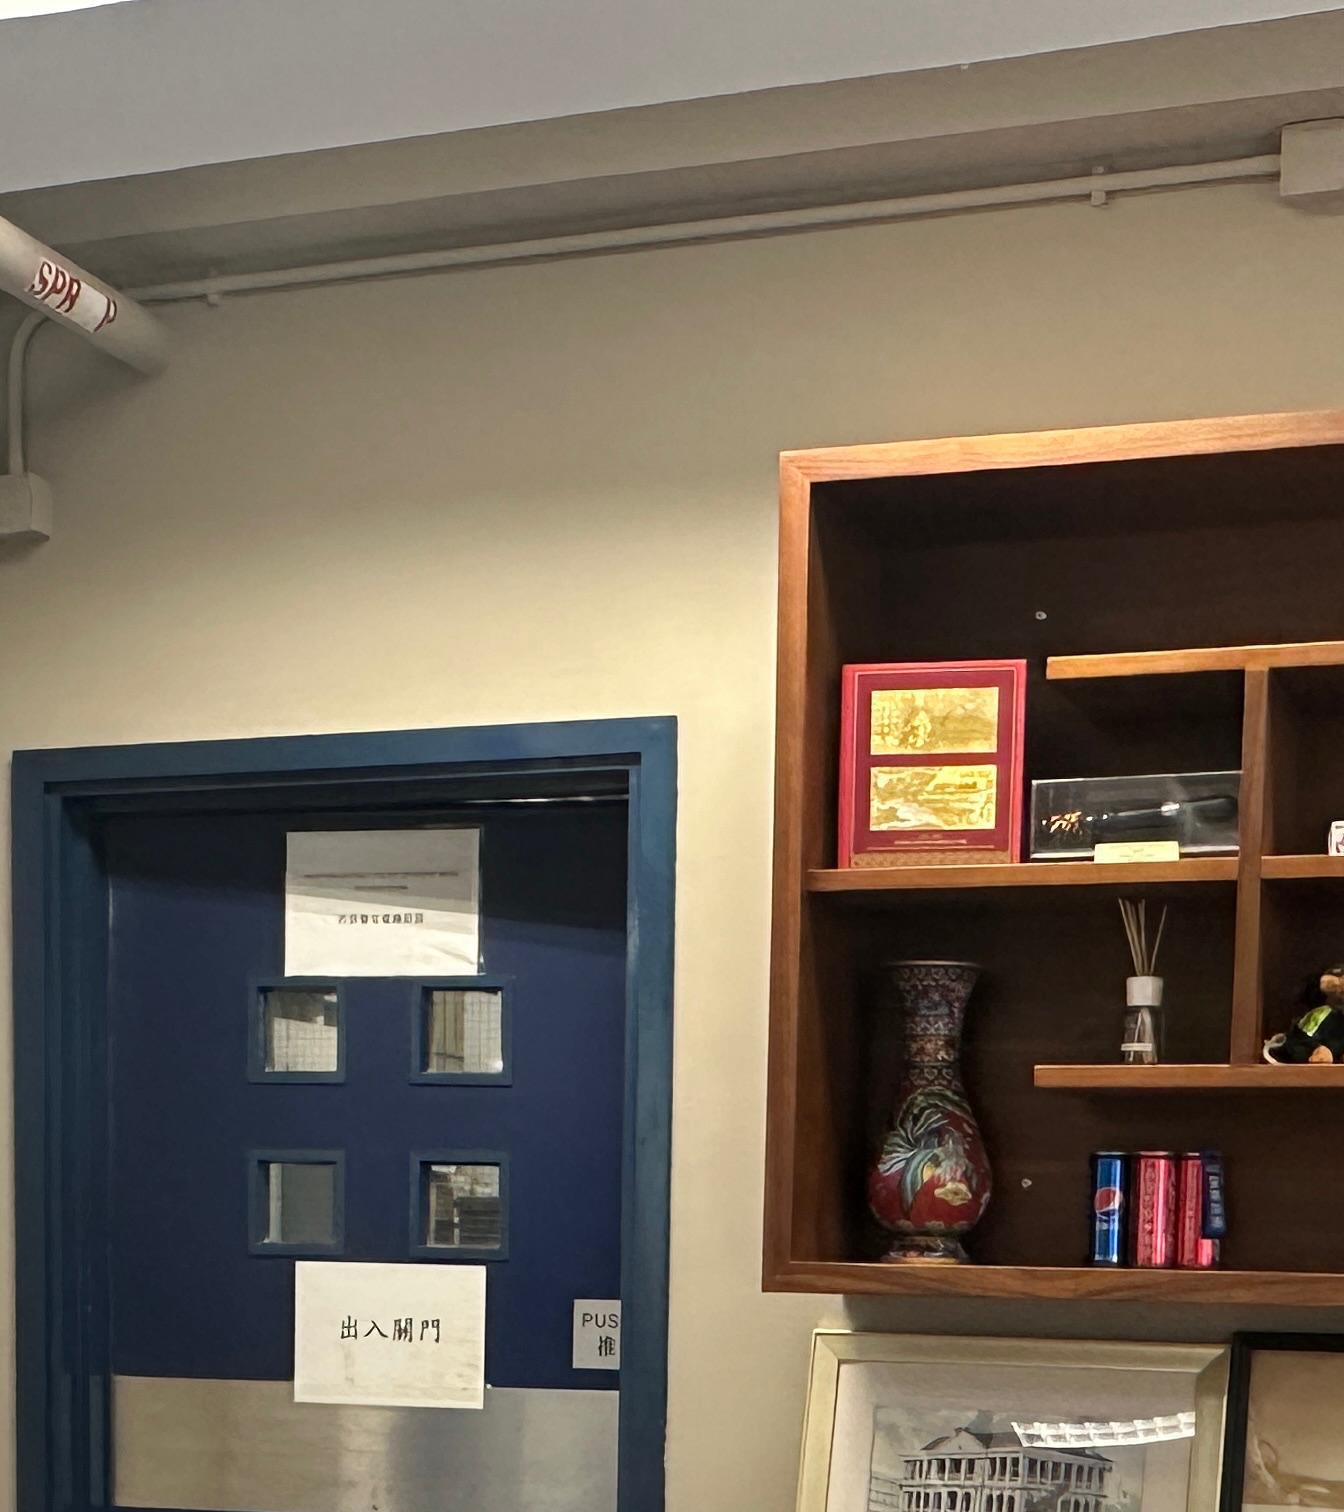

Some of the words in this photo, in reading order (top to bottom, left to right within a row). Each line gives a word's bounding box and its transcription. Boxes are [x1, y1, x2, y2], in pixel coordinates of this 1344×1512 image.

[340, 1315, 440, 1344] 出入關門
[582, 1312, 619, 1329] PUS
[598, 1335, 616, 1357] 推
